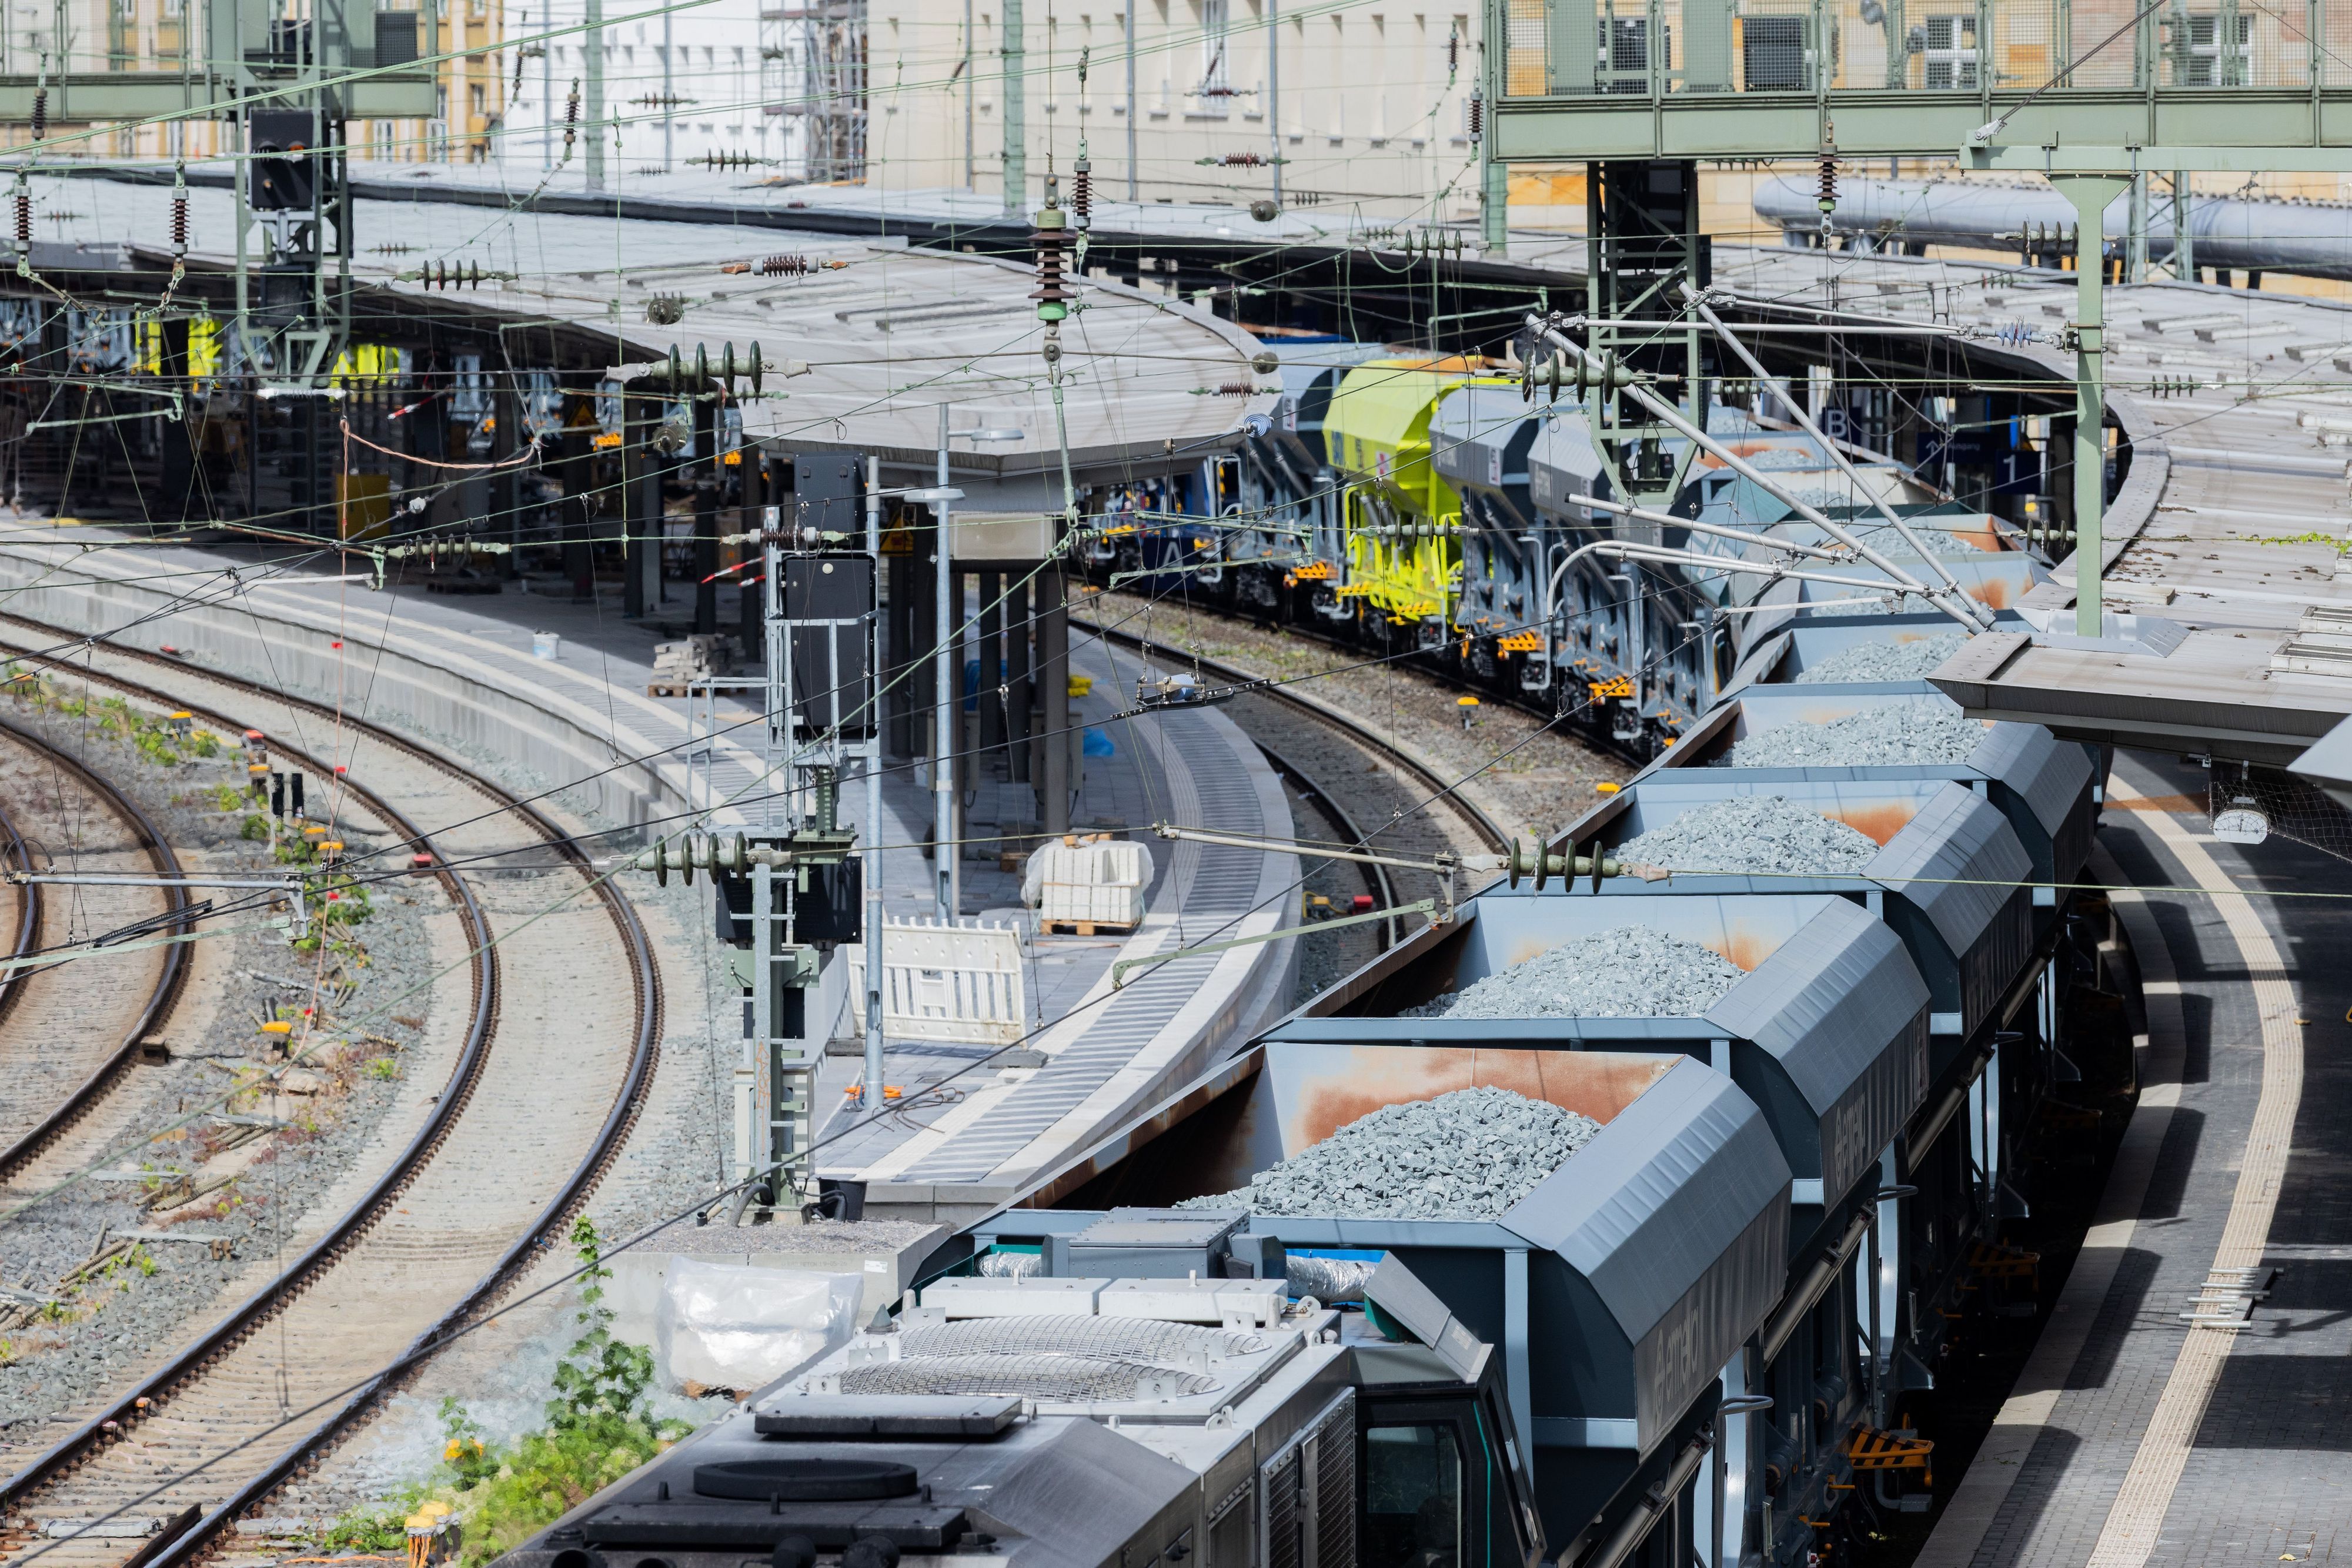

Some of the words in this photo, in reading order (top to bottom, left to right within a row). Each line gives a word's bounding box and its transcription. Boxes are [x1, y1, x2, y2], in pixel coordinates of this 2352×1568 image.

[1828, 409, 1847, 438] B
[2003, 454, 2016, 483] 1
[1158, 541, 1185, 577] A
